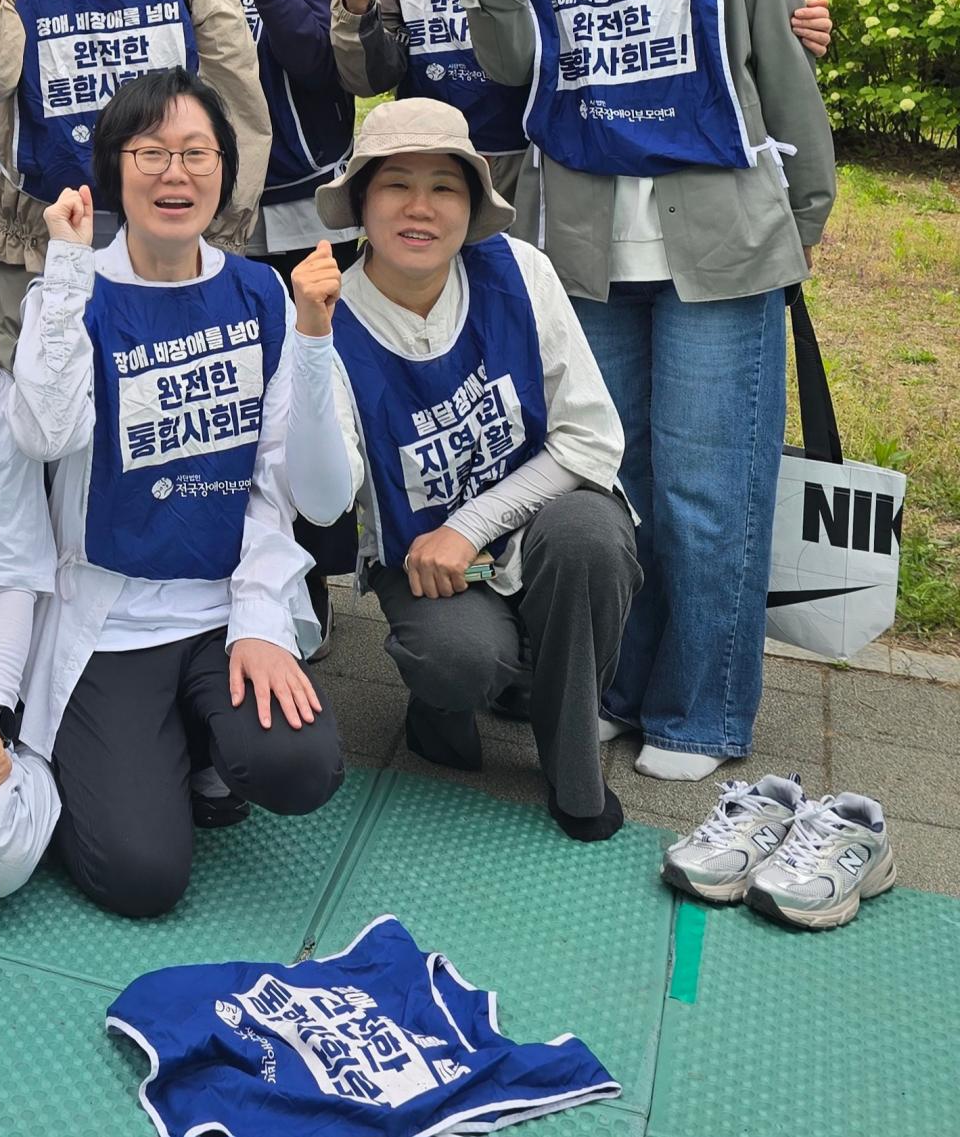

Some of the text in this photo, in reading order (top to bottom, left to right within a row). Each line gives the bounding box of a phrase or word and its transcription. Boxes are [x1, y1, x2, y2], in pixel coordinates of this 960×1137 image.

[36, 1, 180, 36] 장애, 비장애를 넘어
[573, 4, 651, 42] 완전한
[74, 35, 149, 69] 완전한
[559, 34, 688, 81] 통합사회로!
[113, 344, 155, 374] 장애,
[154, 326, 224, 363] 비장애를
[157, 360, 239, 411] 완전한
[751, 825, 780, 853] N
[837, 848, 865, 876] N
